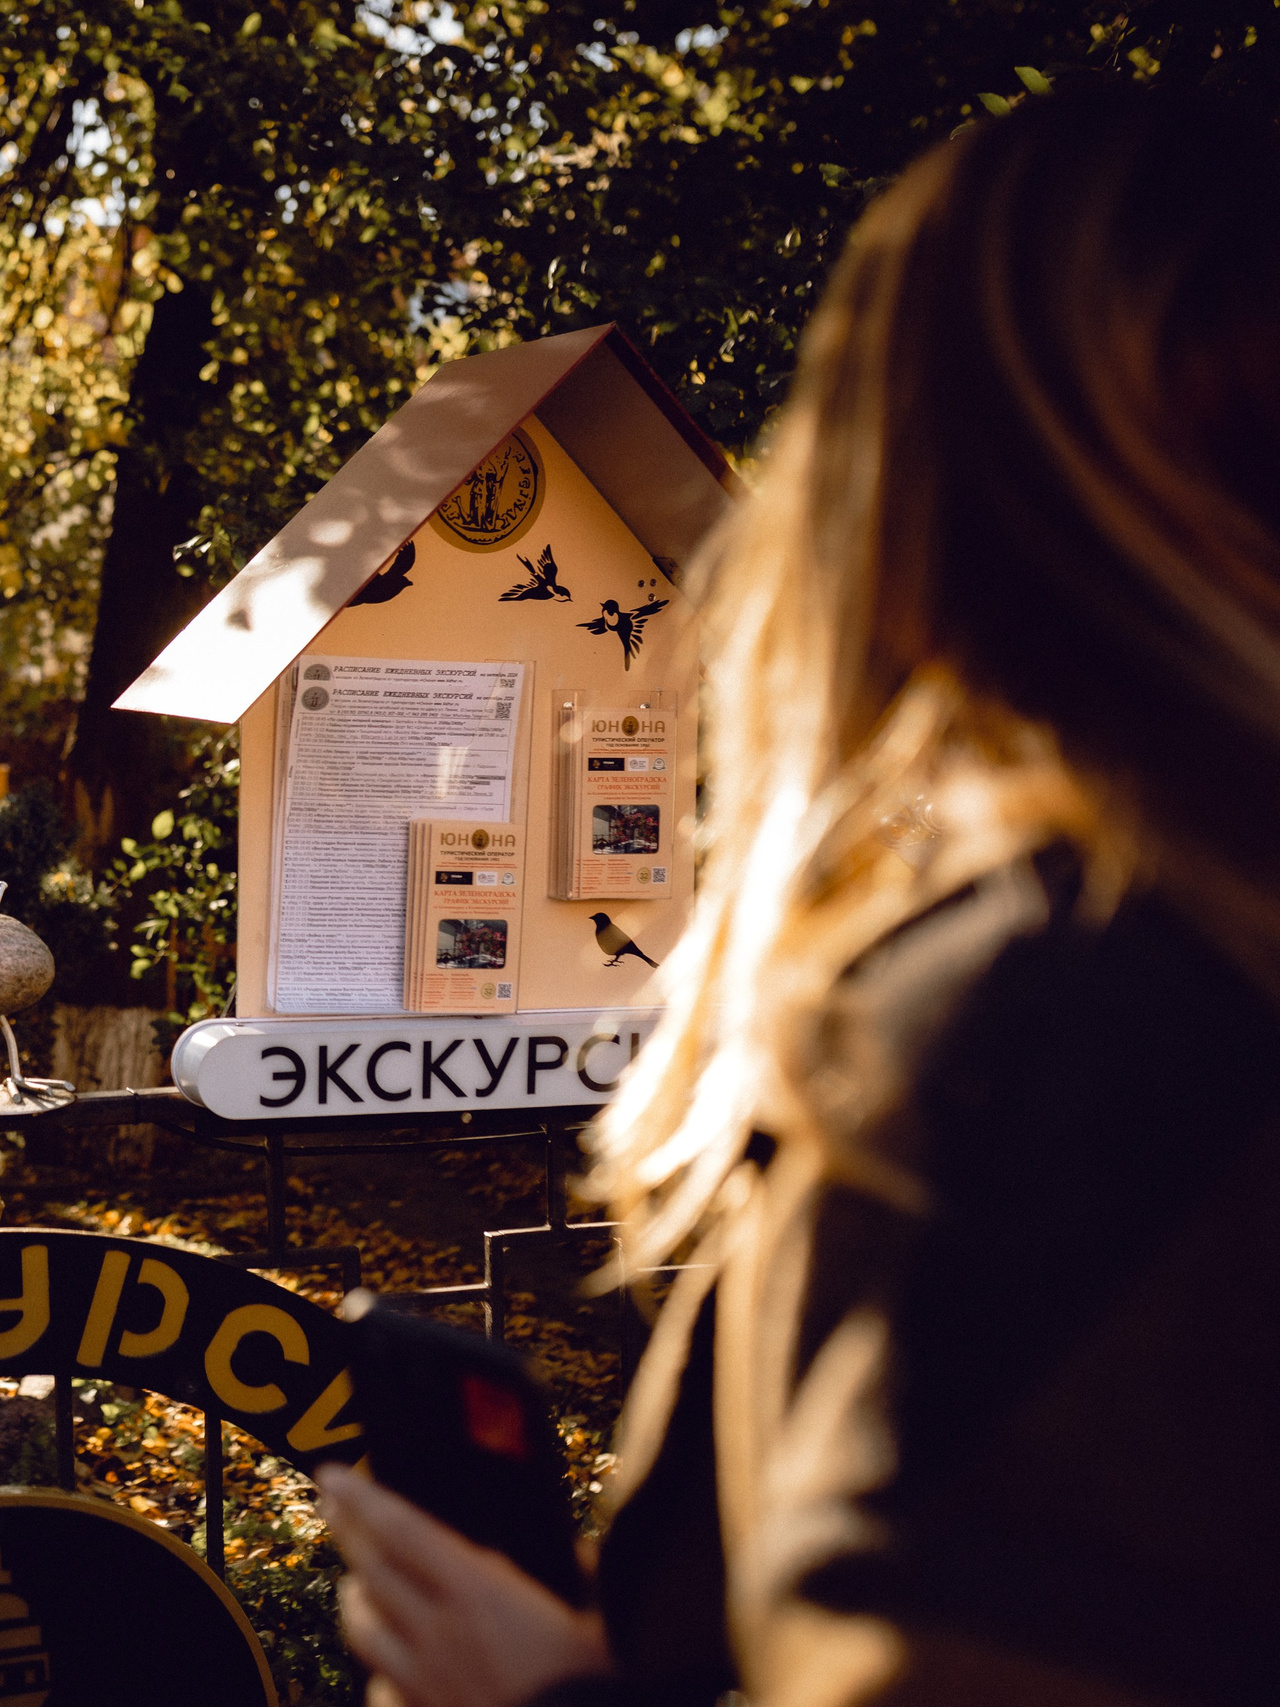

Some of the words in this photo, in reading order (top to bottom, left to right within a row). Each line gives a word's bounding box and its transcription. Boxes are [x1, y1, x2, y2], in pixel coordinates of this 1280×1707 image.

[333, 666, 381, 674] РАСПИСАНИЕ
[385, 668, 433, 676] ЕЖЕДНЕВНЫХ
[435, 669, 477, 677] ЭКСКУРСИЙ
[332, 689, 380, 697] РАСПИСАНИЕ
[383, 691, 430, 699] ЕЖЕДНЕВНЫХ
[433, 692, 474, 700] ЭКСКУРСИЙ
